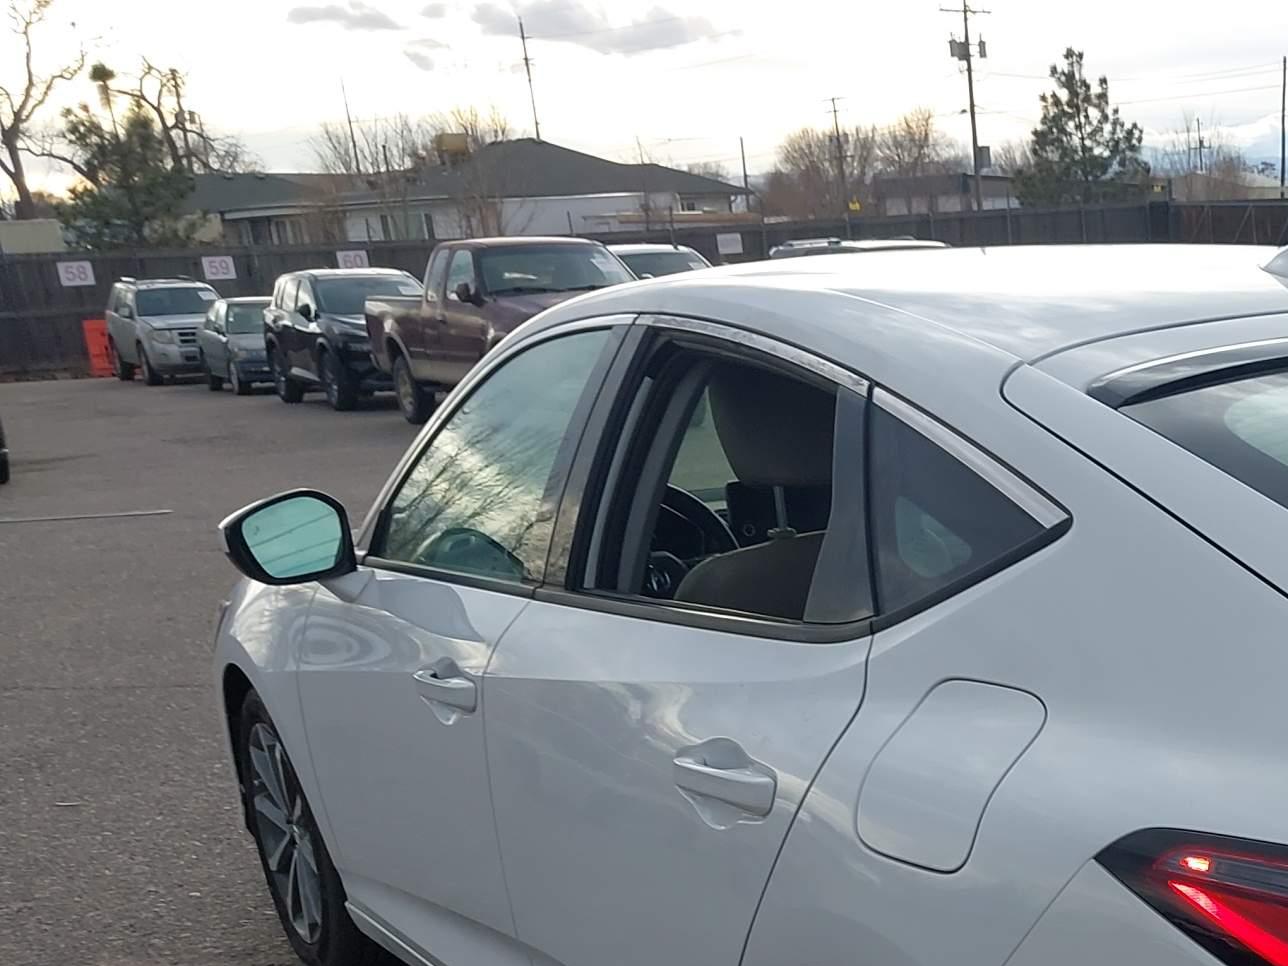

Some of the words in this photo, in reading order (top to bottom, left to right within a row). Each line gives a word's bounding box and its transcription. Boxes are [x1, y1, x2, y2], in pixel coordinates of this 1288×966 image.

[208, 259, 230, 275] 59
[343, 254, 363, 268] 60
[64, 264, 88, 281] 58
